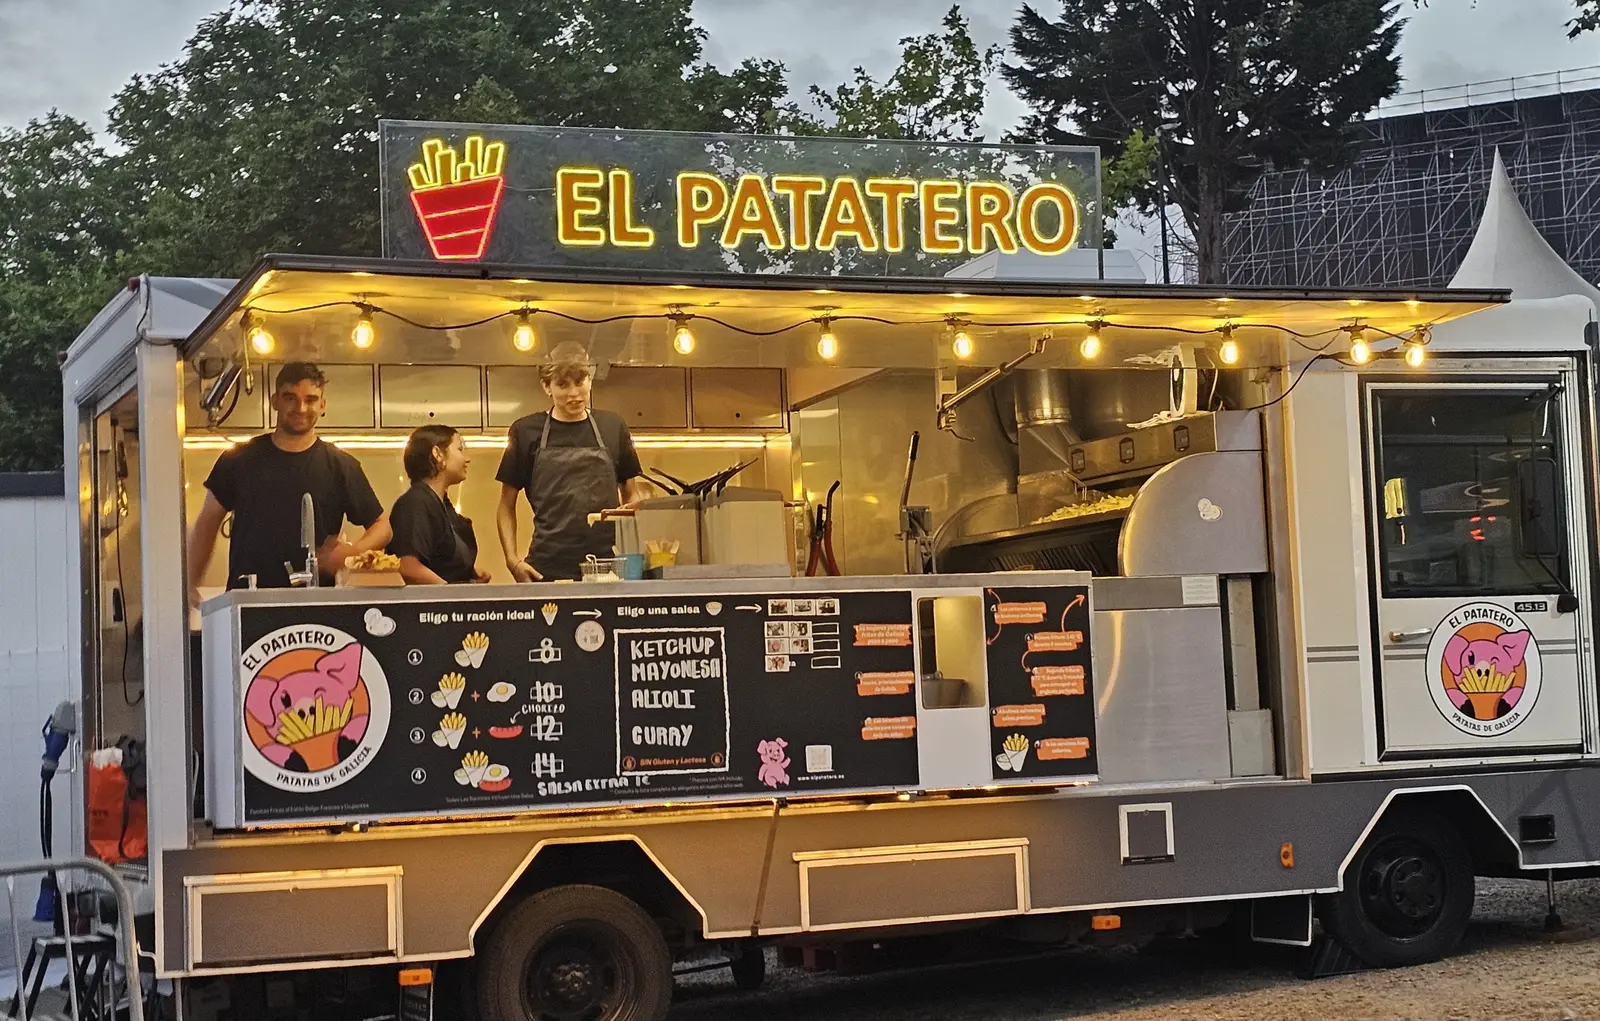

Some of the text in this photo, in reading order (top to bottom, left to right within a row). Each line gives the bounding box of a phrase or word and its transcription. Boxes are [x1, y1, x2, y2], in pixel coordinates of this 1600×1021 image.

[556, 167, 1081, 256] EL PATATERO
[452, 612, 464, 622] tu
[467, 610, 504, 622] ración
[648, 607, 668, 615] una
[671, 604, 700, 614] salsa
[1448, 608, 1514, 629] EL PATATERO
[1516, 603, 1546, 612] 45.13
[242, 630, 336, 671] EL PATATERO
[540, 637, 554, 664] 8
[630, 636, 715, 660] KETCHUP
[632, 658, 721, 682] MAYONESA
[536, 680, 555, 703] 10
[632, 689, 696, 709] ALIOLI
[536, 714, 560, 741] 12
[1452, 712, 1482, 732] PATATAS
[1494, 712, 1520, 731] GALICIA
[632, 724, 694, 747] CURRY
[276, 746, 372, 788] PATATAS DE GALICIA
[535, 752, 556, 779] 14
[640, 758, 652, 766] SIN
[652, 758, 675, 766] Gluten
[537, 780, 584, 796] SALSA
[585, 776, 629, 792] EXTRA
